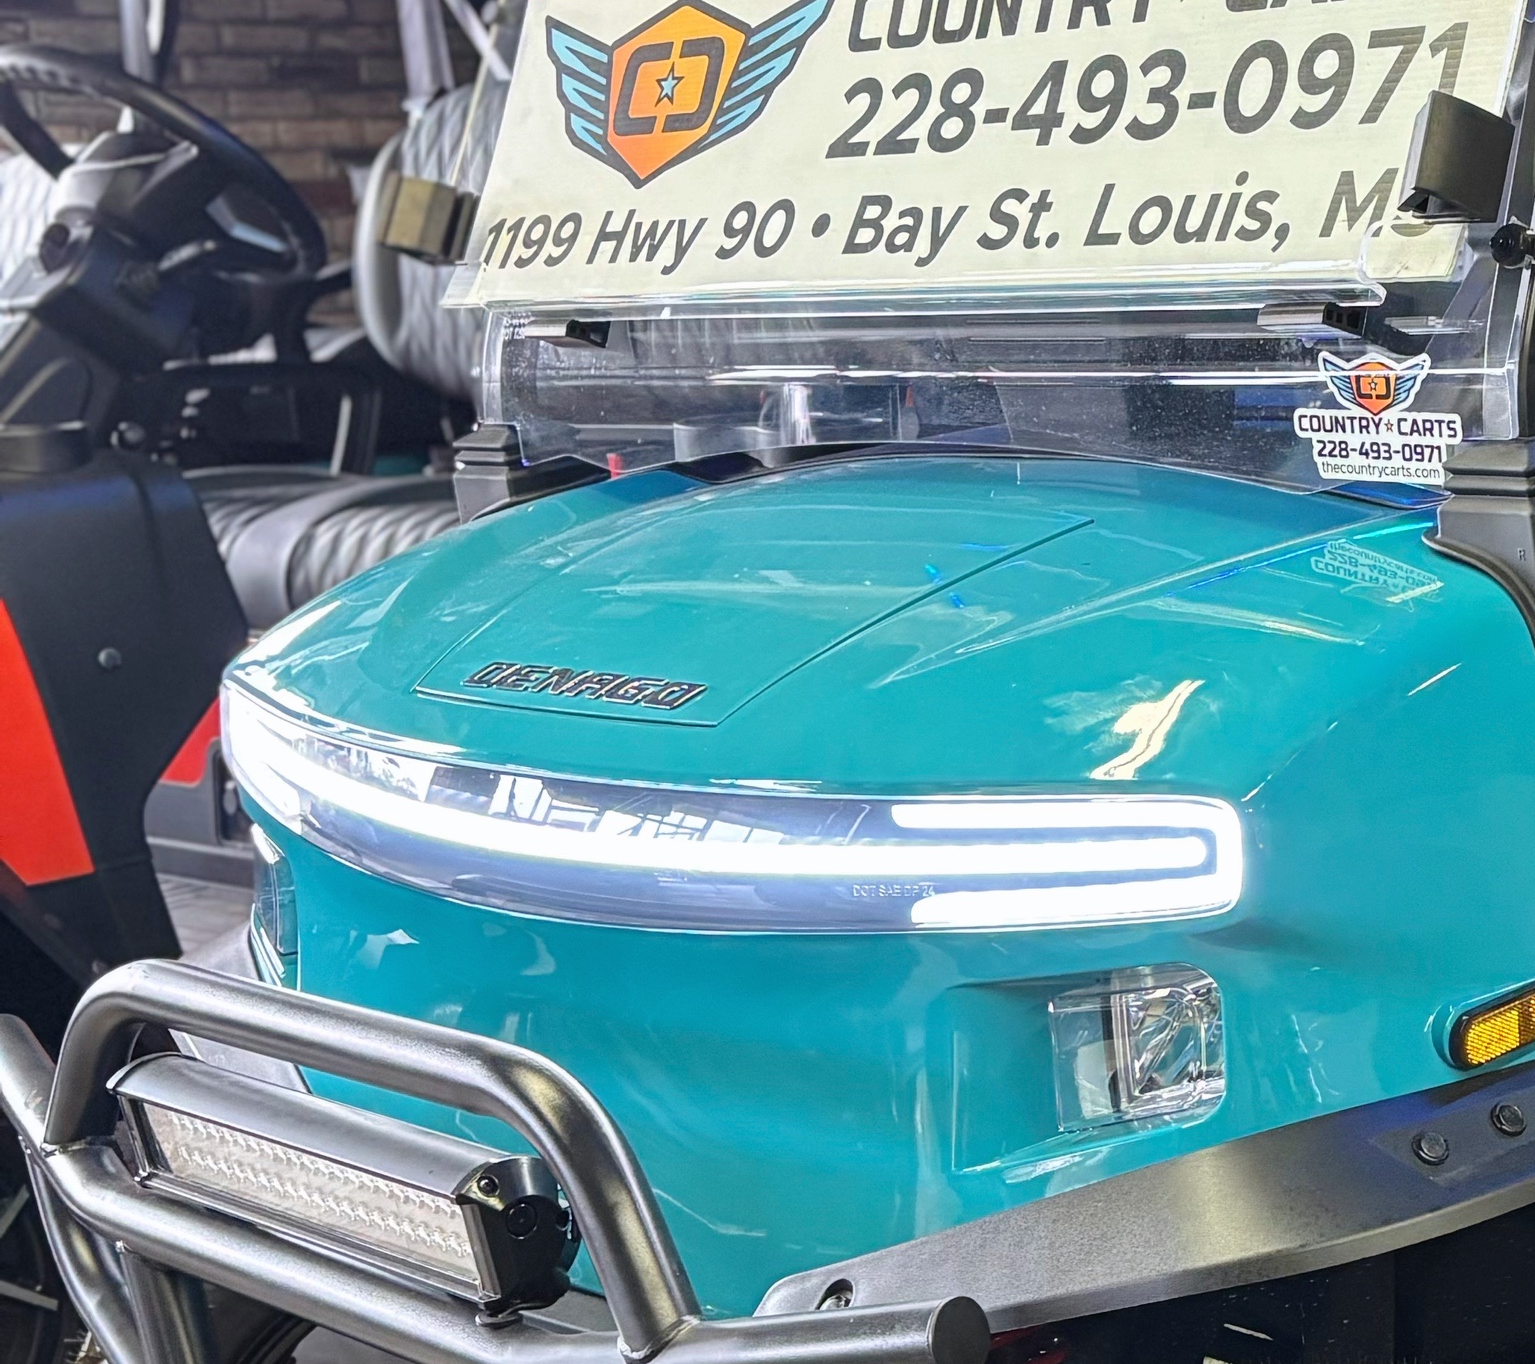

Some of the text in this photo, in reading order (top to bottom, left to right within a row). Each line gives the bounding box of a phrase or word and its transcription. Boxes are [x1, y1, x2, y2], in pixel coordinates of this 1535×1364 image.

[825, 21, 1469, 159] 228-493-0971
[482, 167, 1435, 276] 1199 Hwy 90 Bay St. Louis, M
[1297, 413, 1458, 439] COUNTRY CARTS
[1316, 439, 1443, 464] 228-493-0971
[1321, 460, 1441, 480] thecountrycarts.com
[460, 661, 709, 711] DENAGO
[852, 884, 876, 897] DOT
[878, 883, 901, 897] SAE
